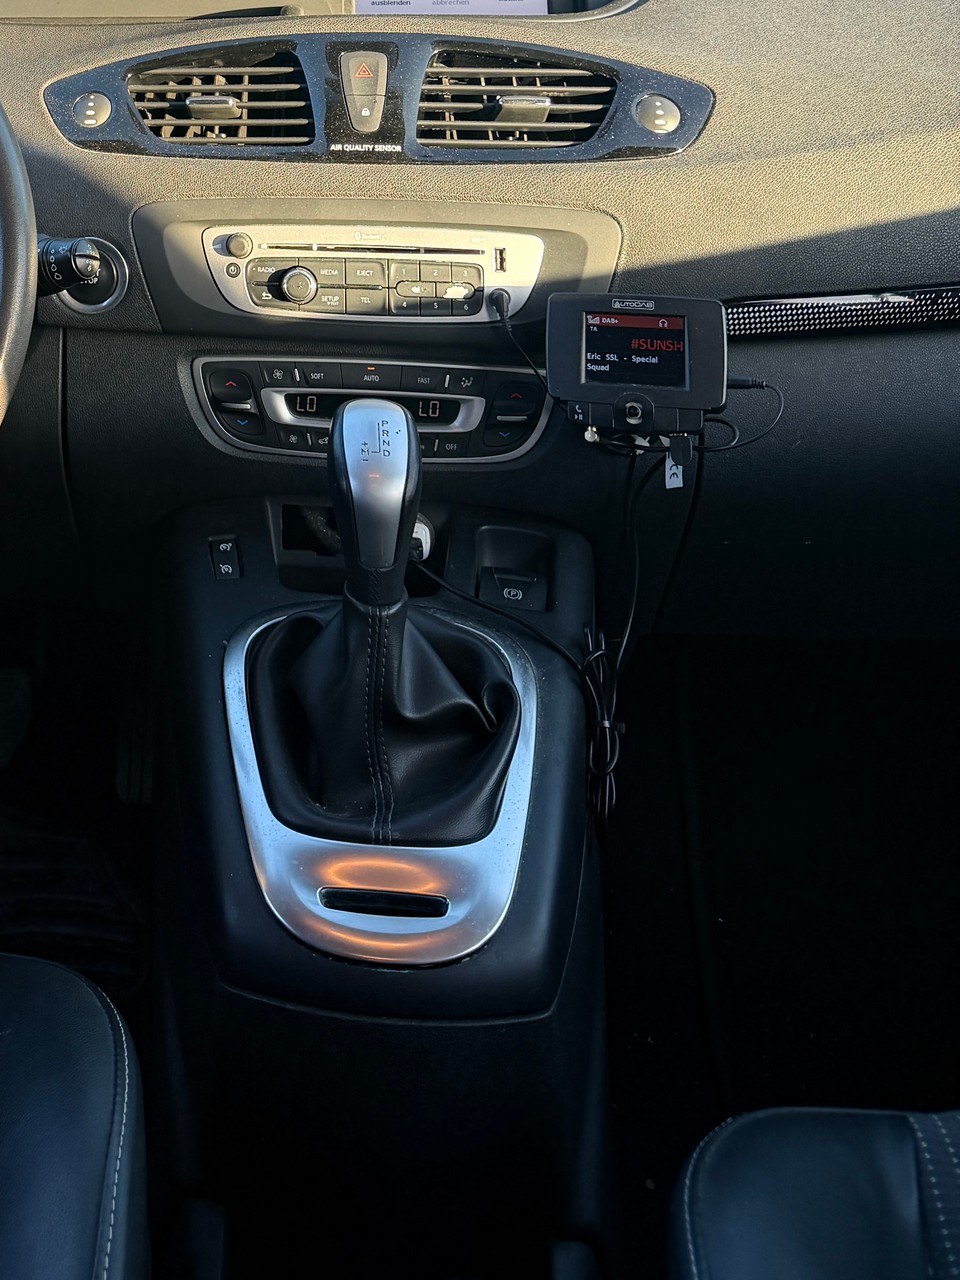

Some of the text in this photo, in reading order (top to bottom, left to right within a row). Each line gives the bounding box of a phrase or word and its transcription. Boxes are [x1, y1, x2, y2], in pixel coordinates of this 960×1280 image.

[343, 144, 373, 152] QUALITY
[374, 144, 402, 152] SENSOR
[361, 296, 371, 304] TEL
[464, 303, 469, 311] 6
[631, 339, 684, 352] #SUNSH
[605, 354, 619, 362] SSL
[631, 355, 658, 364] Special
[587, 363, 610, 372] Squad
[296, 396, 317, 412] LO
[418, 400, 440, 417] LO
[445, 443, 458, 451] OFF
[383, 449, 391, 457] D
